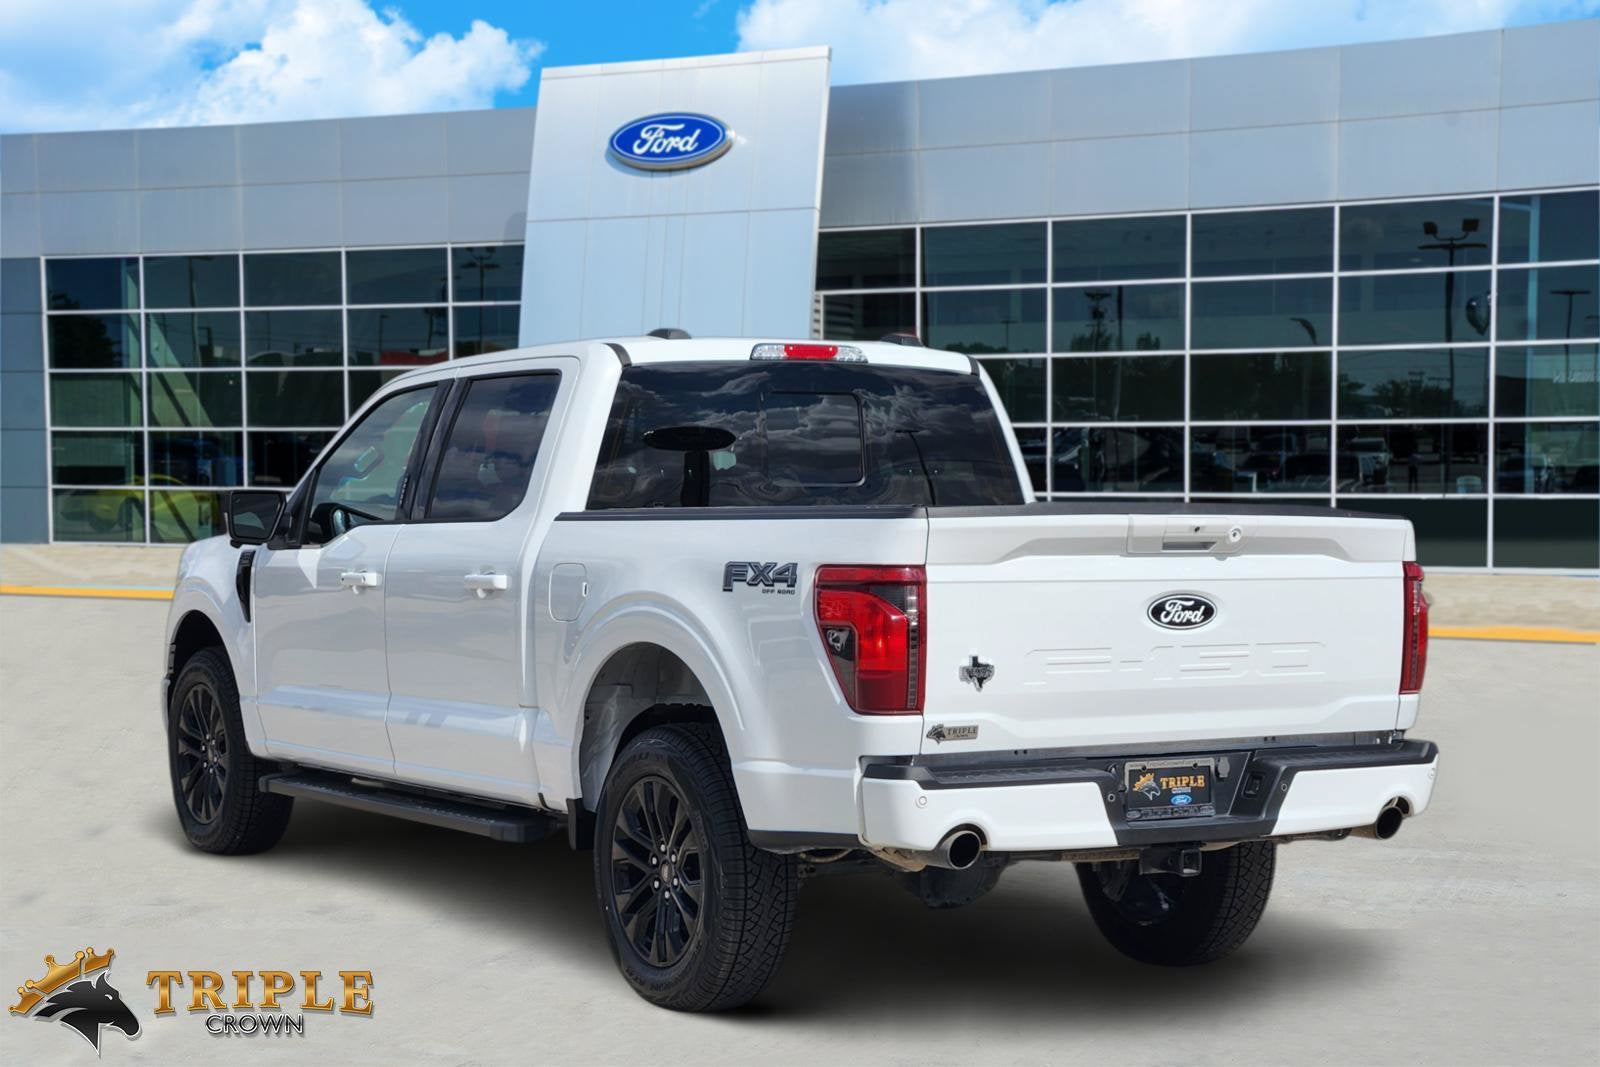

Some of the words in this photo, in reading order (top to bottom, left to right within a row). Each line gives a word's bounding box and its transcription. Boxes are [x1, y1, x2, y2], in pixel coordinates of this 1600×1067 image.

[632, 123, 702, 155] Ford
[722, 561, 798, 592] FX4
[1160, 599, 1206, 624] Ford
[1160, 775, 1205, 789] TRIPLE
